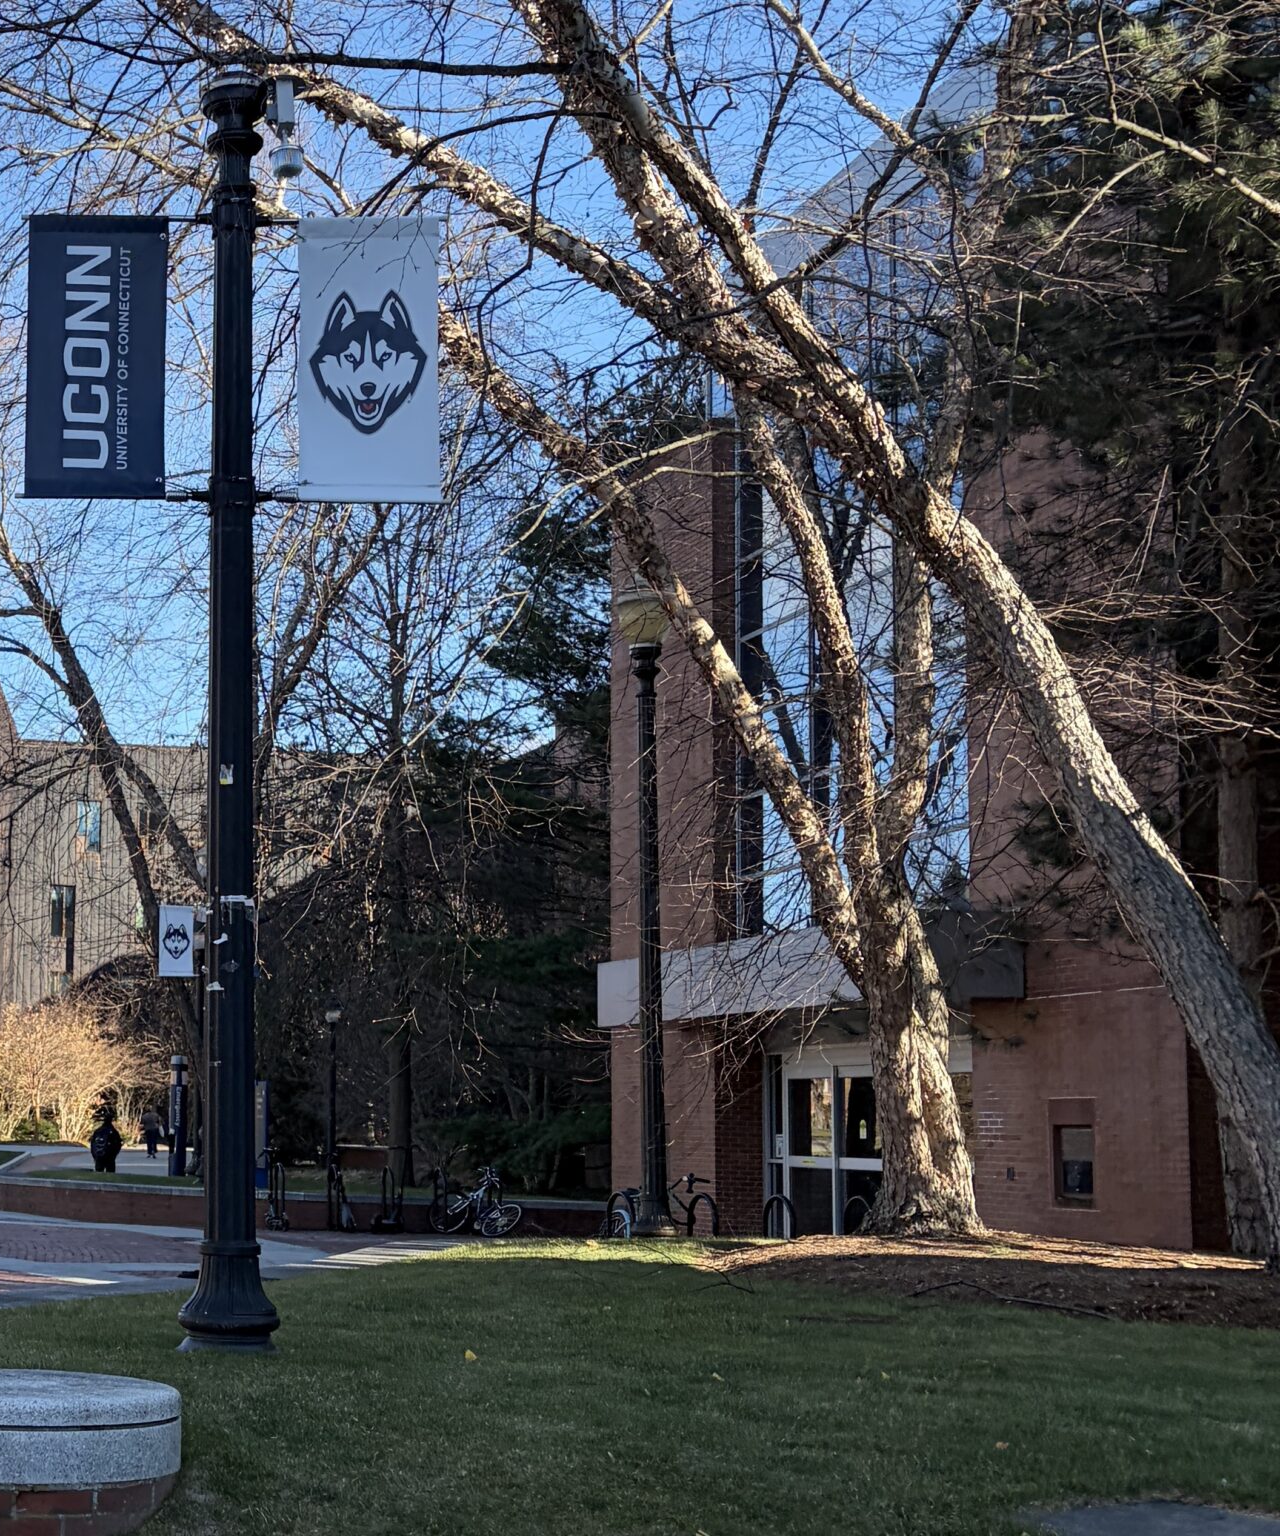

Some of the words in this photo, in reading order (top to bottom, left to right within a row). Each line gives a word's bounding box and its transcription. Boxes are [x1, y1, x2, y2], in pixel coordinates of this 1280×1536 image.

[117, 247, 132, 353] CONNECTICUT
[62, 245, 112, 469] UCONN
[117, 358, 129, 379] OF
[116, 385, 128, 470] UNIVERSITY
